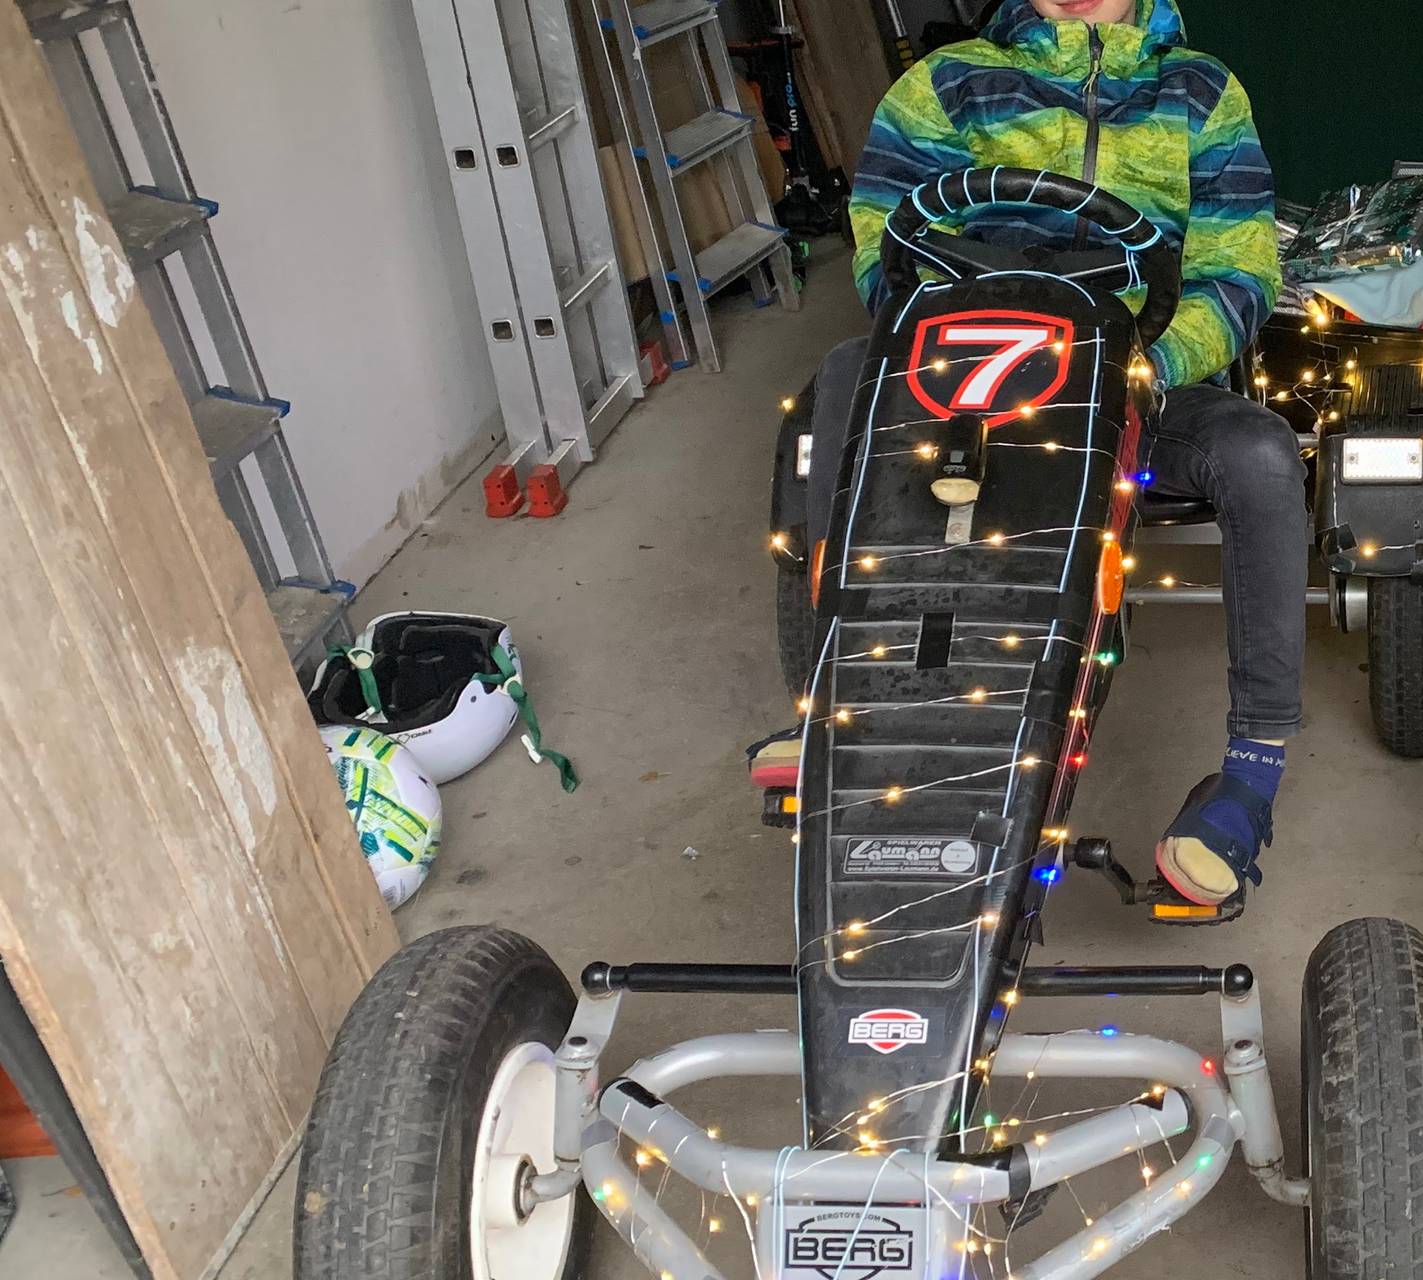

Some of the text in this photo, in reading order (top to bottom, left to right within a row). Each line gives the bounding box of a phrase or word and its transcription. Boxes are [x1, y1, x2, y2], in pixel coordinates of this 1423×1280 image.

[789, 109, 799, 132] fun
[938, 325, 1056, 409] 7
[1262, 755, 1273, 765] IN
[849, 840, 941, 861] Laumann
[853, 1022, 923, 1039] BERG
[816, 1211, 882, 1222] BERGTOYSCOM
[793, 1236, 905, 1263] BERG
